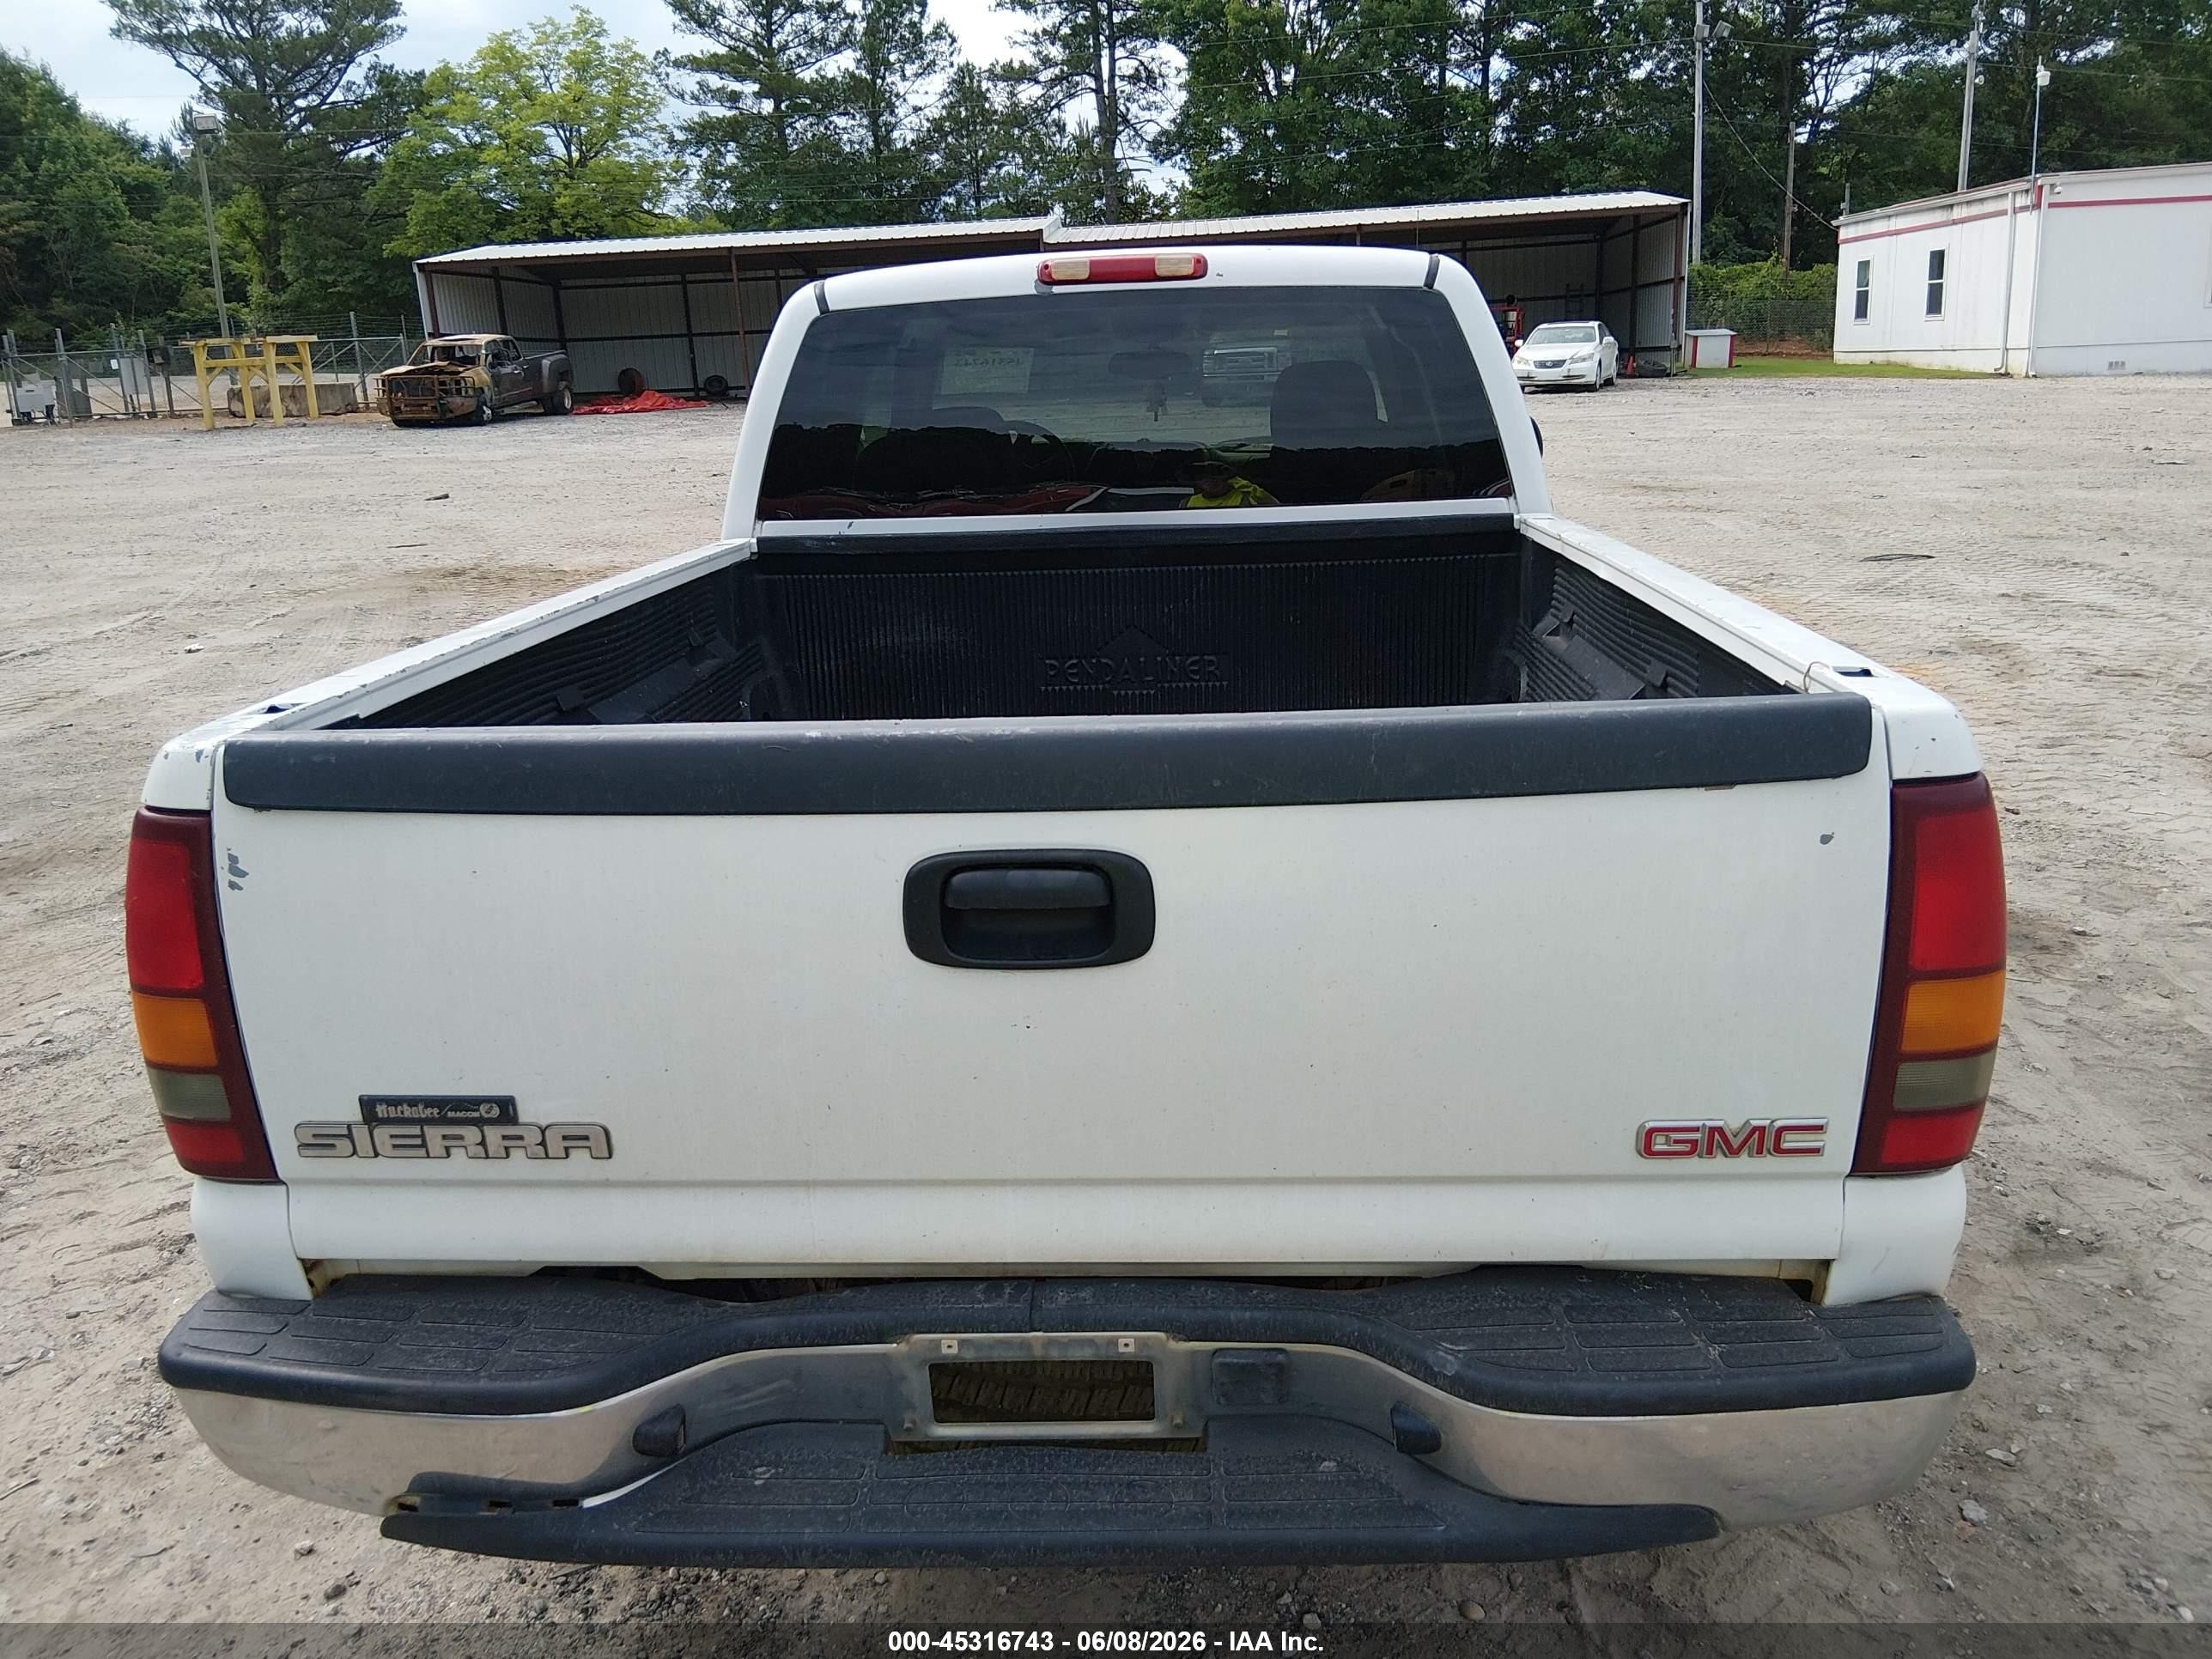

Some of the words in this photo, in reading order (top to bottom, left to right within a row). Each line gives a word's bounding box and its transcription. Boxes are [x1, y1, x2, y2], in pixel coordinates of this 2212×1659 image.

[1044, 655, 1221, 684] PENDALINER
[295, 1123, 611, 1159] SIERRA
[1636, 1118, 1829, 1158] GMC
